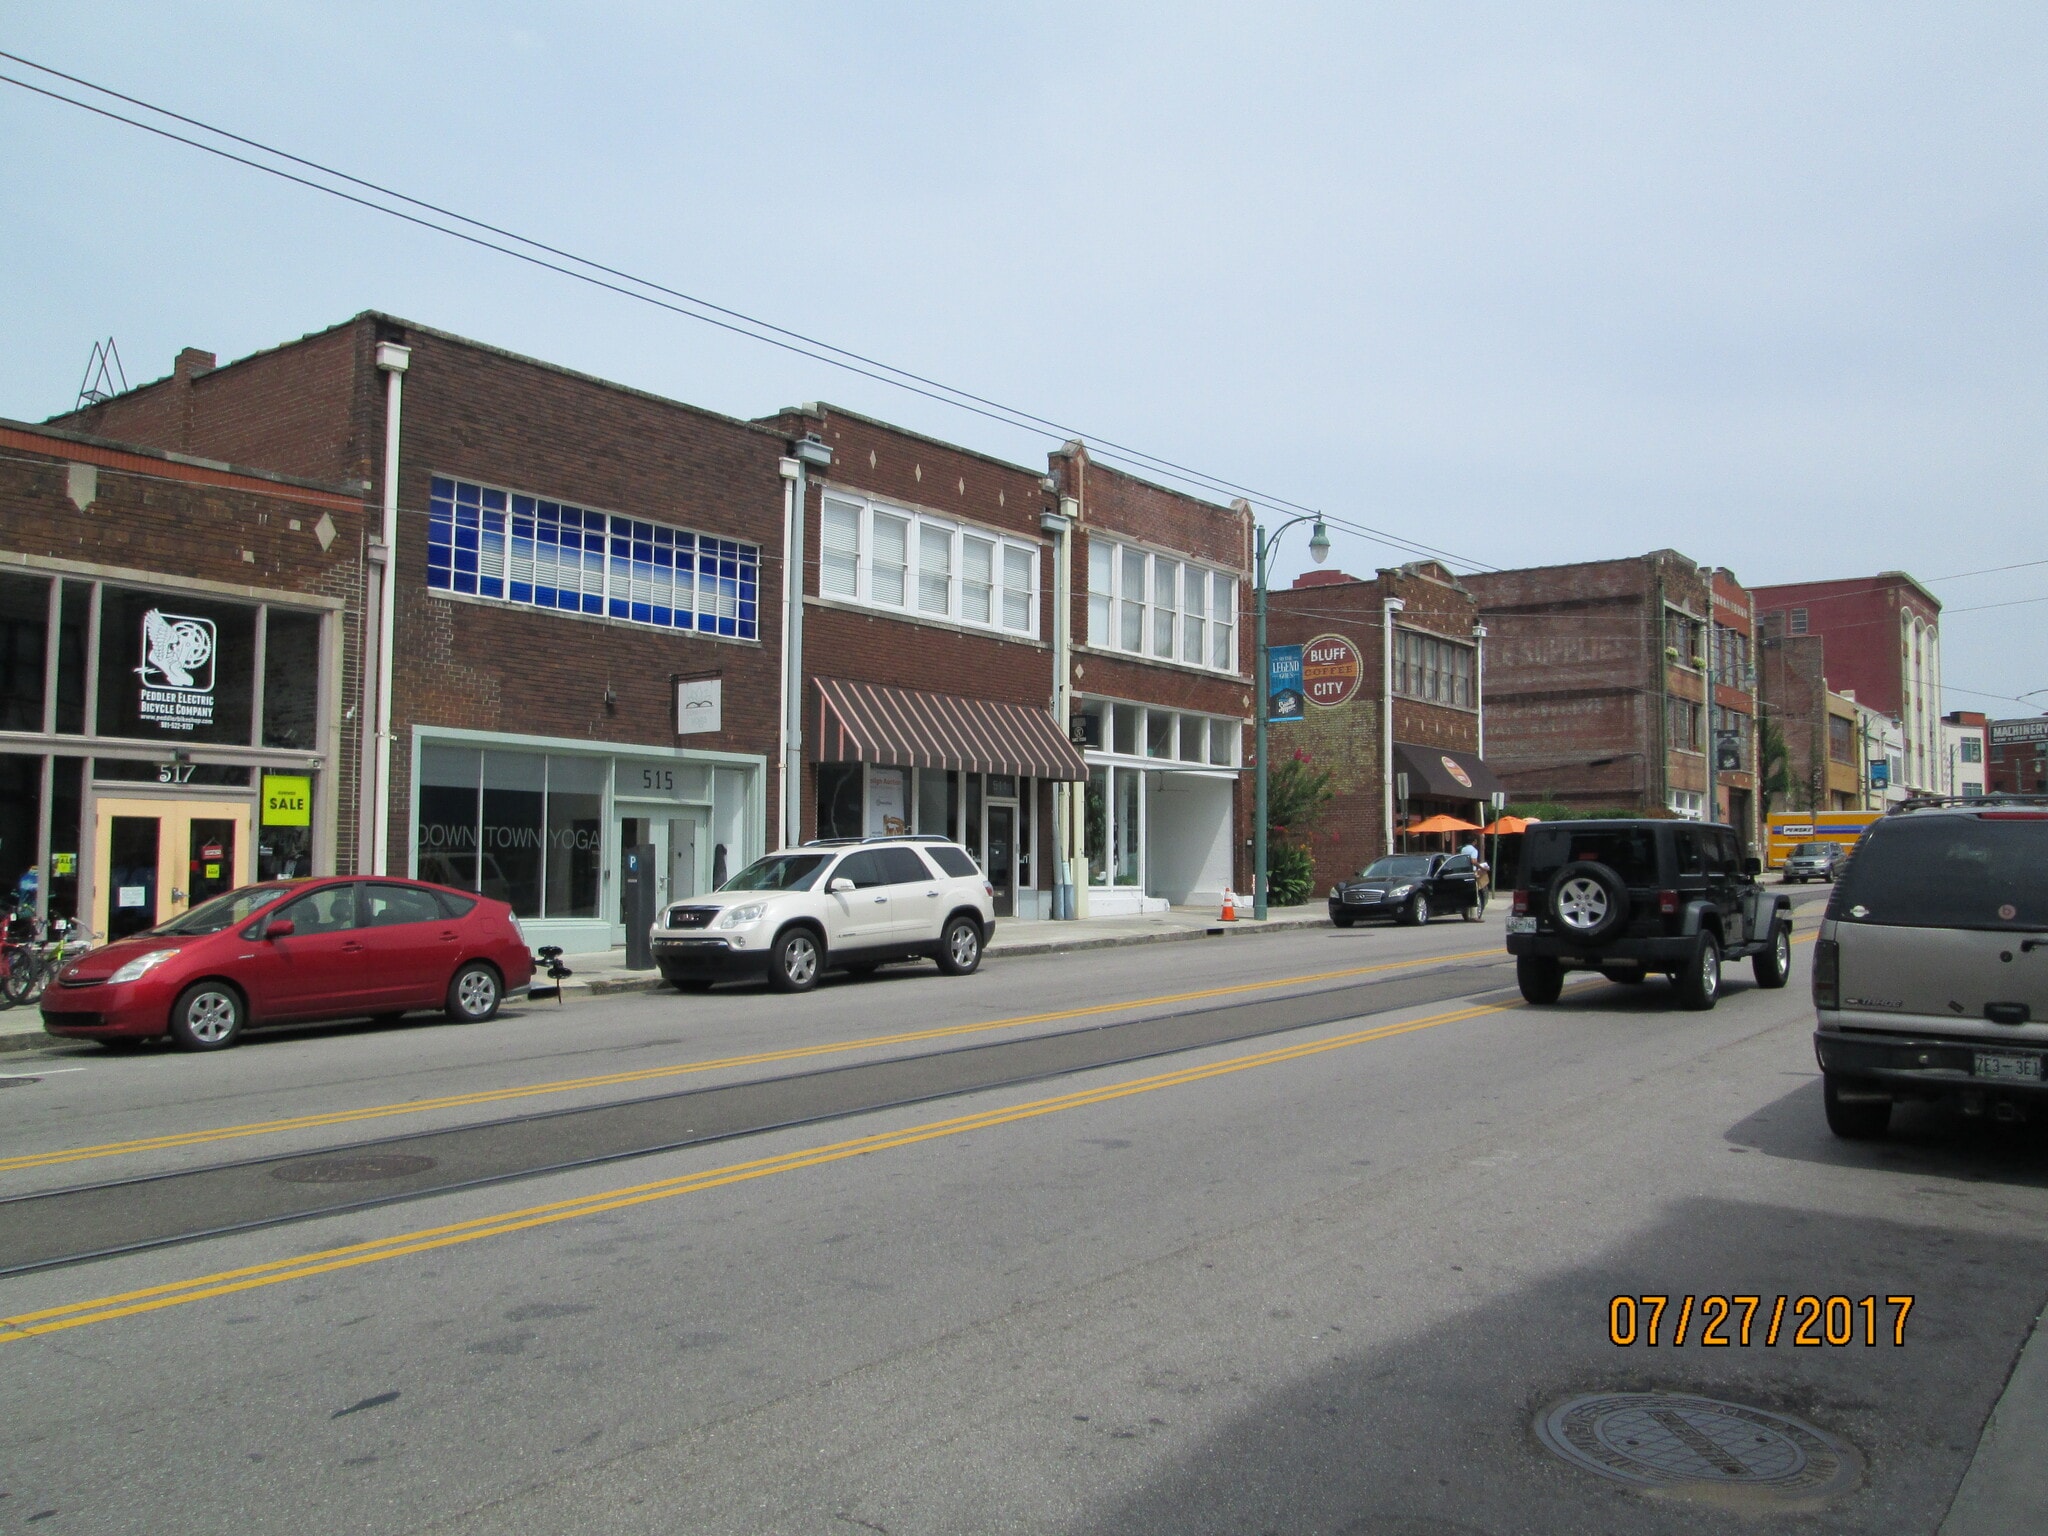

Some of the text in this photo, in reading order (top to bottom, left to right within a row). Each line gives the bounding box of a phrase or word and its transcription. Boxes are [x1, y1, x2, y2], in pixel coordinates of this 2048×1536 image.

[1310, 647, 1346, 662] BLUFF
[1272, 660, 1300, 673] LEGEND
[1304, 665, 1353, 676] COFFEE
[1313, 681, 1344, 696] CITY
[141, 689, 214, 706] PEDDLER ELECTRIC
[141, 701, 214, 718] BICYCLE COMPANY
[1993, 723, 2048, 738] MACHINERY
[159, 764, 197, 783] 517
[643, 769, 673, 790] 515
[269, 797, 304, 811] SALE
[419, 823, 601, 850] DOWN TOWN YOGA
[630, 855, 637, 869] P
